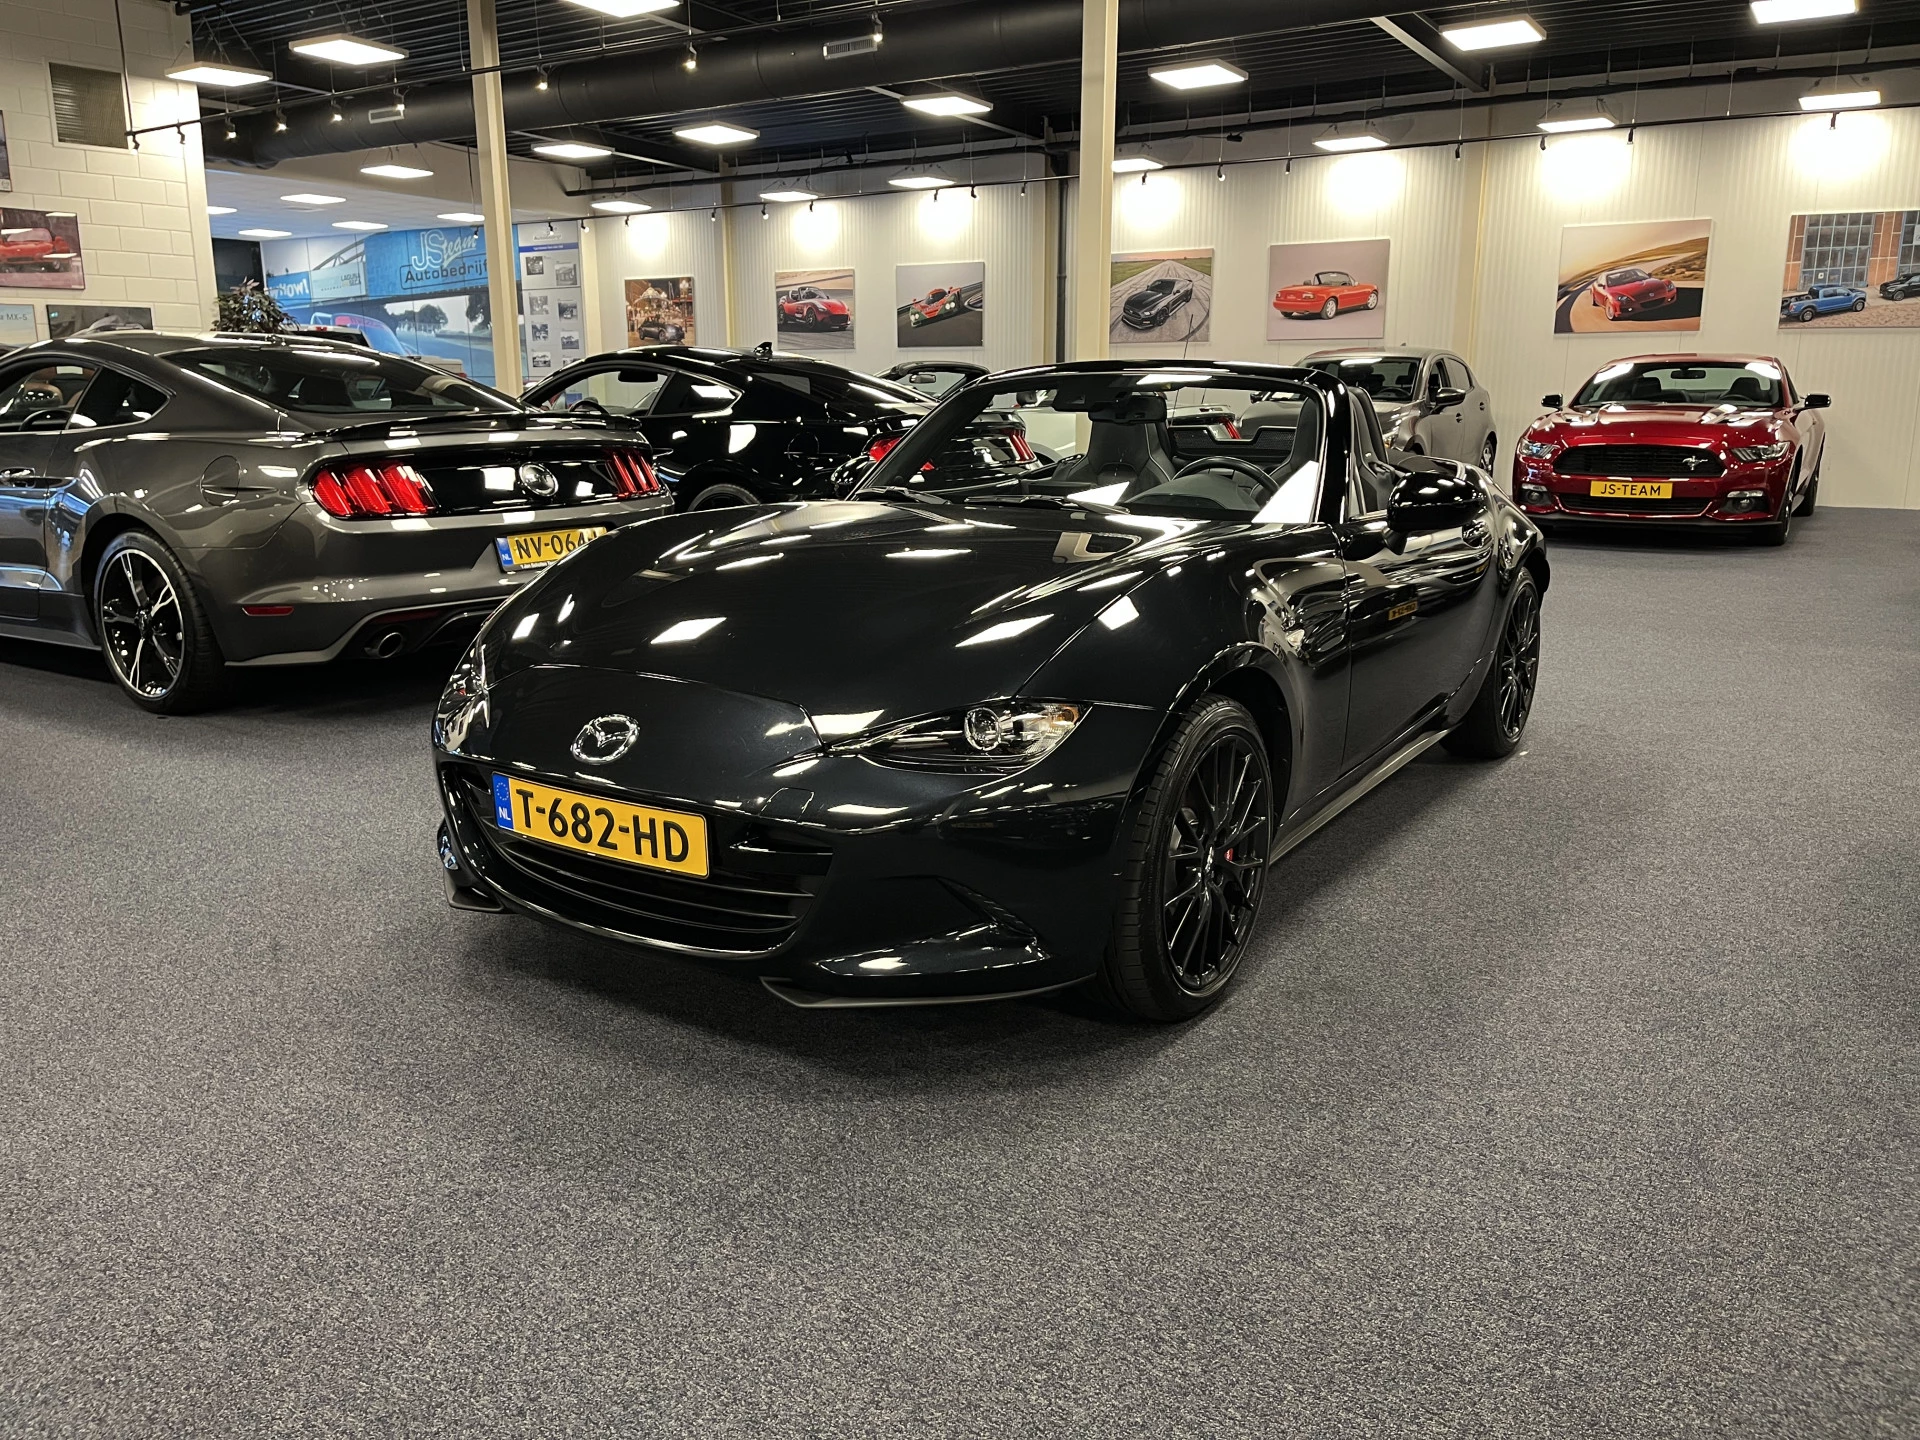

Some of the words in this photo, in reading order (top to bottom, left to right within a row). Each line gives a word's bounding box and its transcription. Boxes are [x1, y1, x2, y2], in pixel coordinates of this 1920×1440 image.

[404, 260, 488, 283] Autobedrijf
[6, 313, 28, 321] MX-5
[1600, 483, 1661, 496] JS-TEAM
[498, 806, 511, 821] NL
[516, 788, 689, 862] T-682-HD
